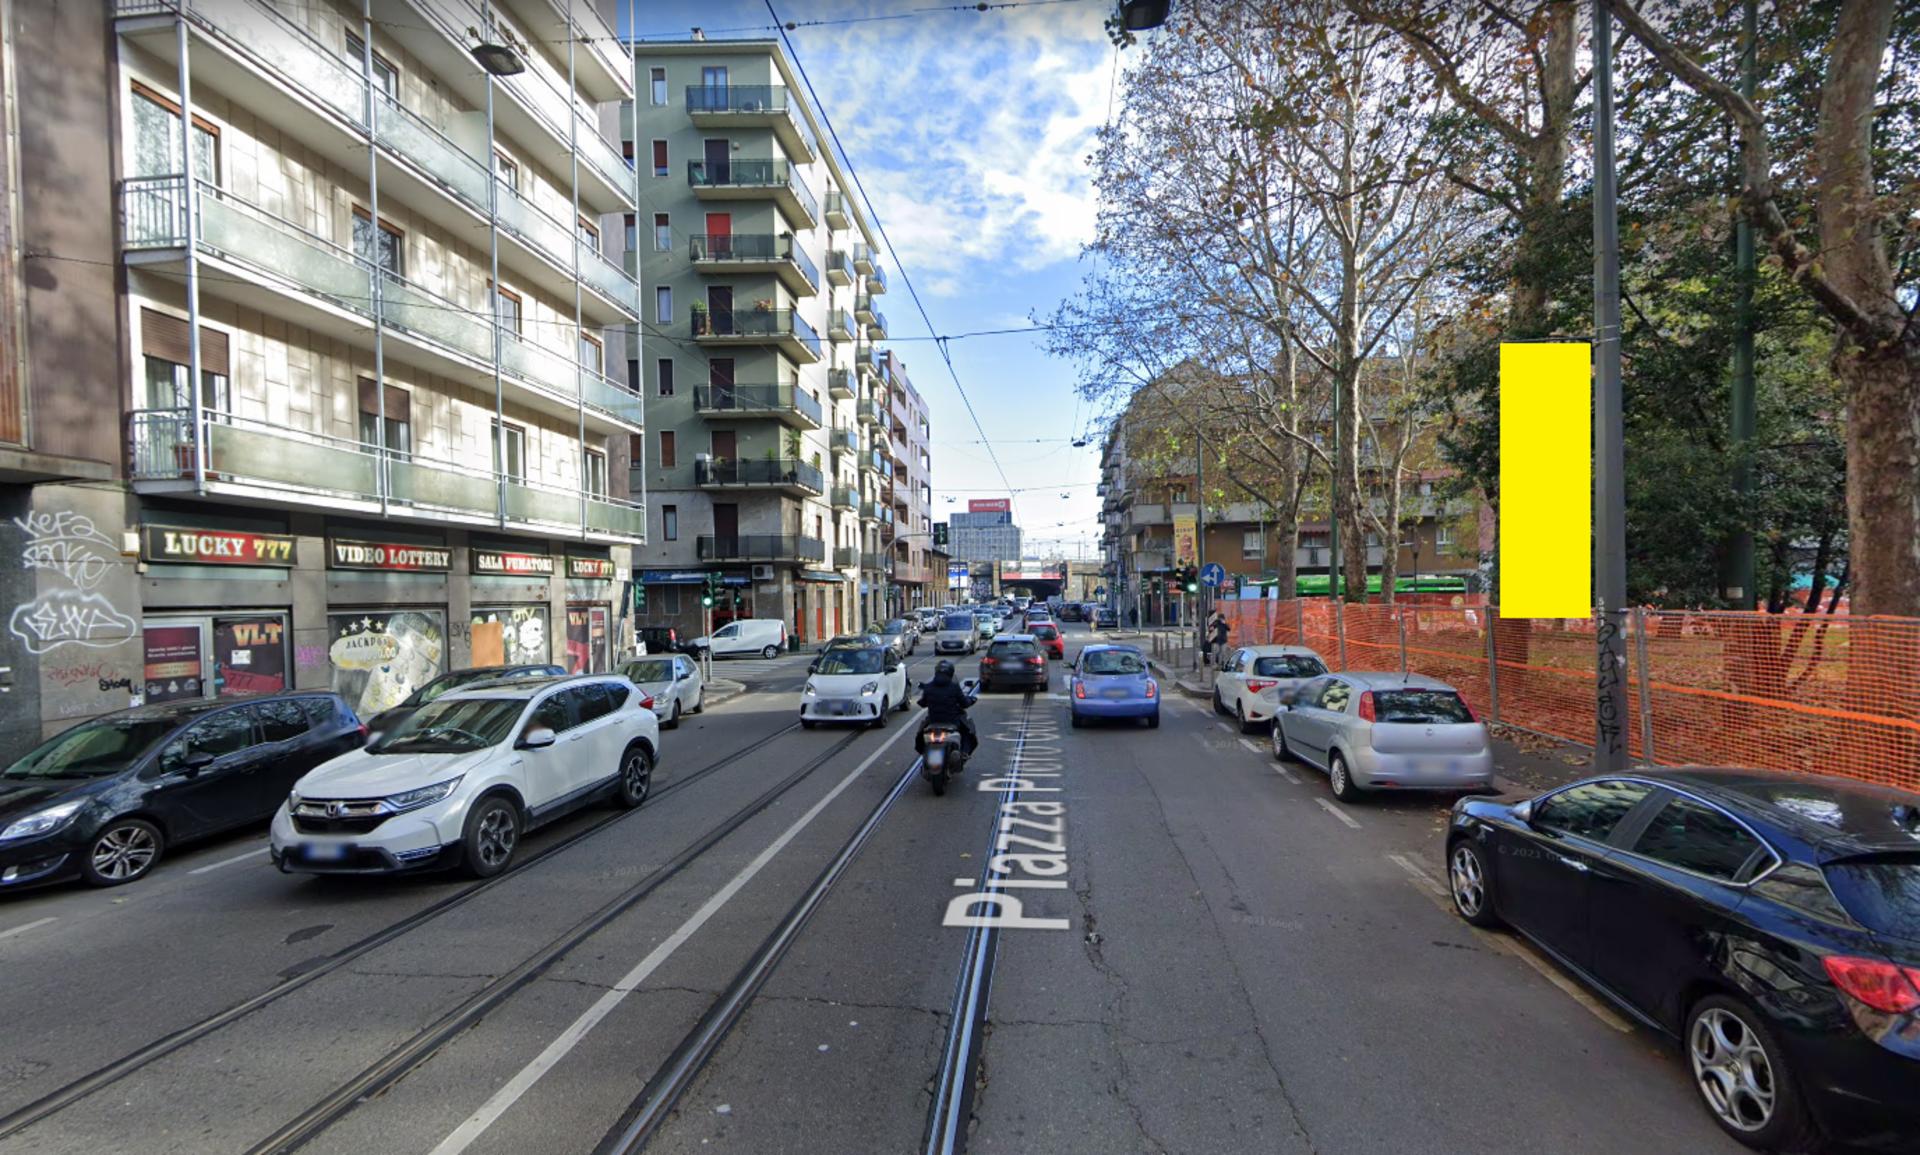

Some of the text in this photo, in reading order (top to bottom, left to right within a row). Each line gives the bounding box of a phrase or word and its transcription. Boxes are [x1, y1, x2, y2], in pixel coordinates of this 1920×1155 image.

[164, 532, 292, 560] LUCKY 777
[336, 545, 449, 566] VIDEO LOTTERY
[478, 554, 553, 571] SALA FUMATORI
[573, 561, 599, 573] LUCKY
[568, 612, 588, 626] VLT
[232, 624, 283, 647] VLT
